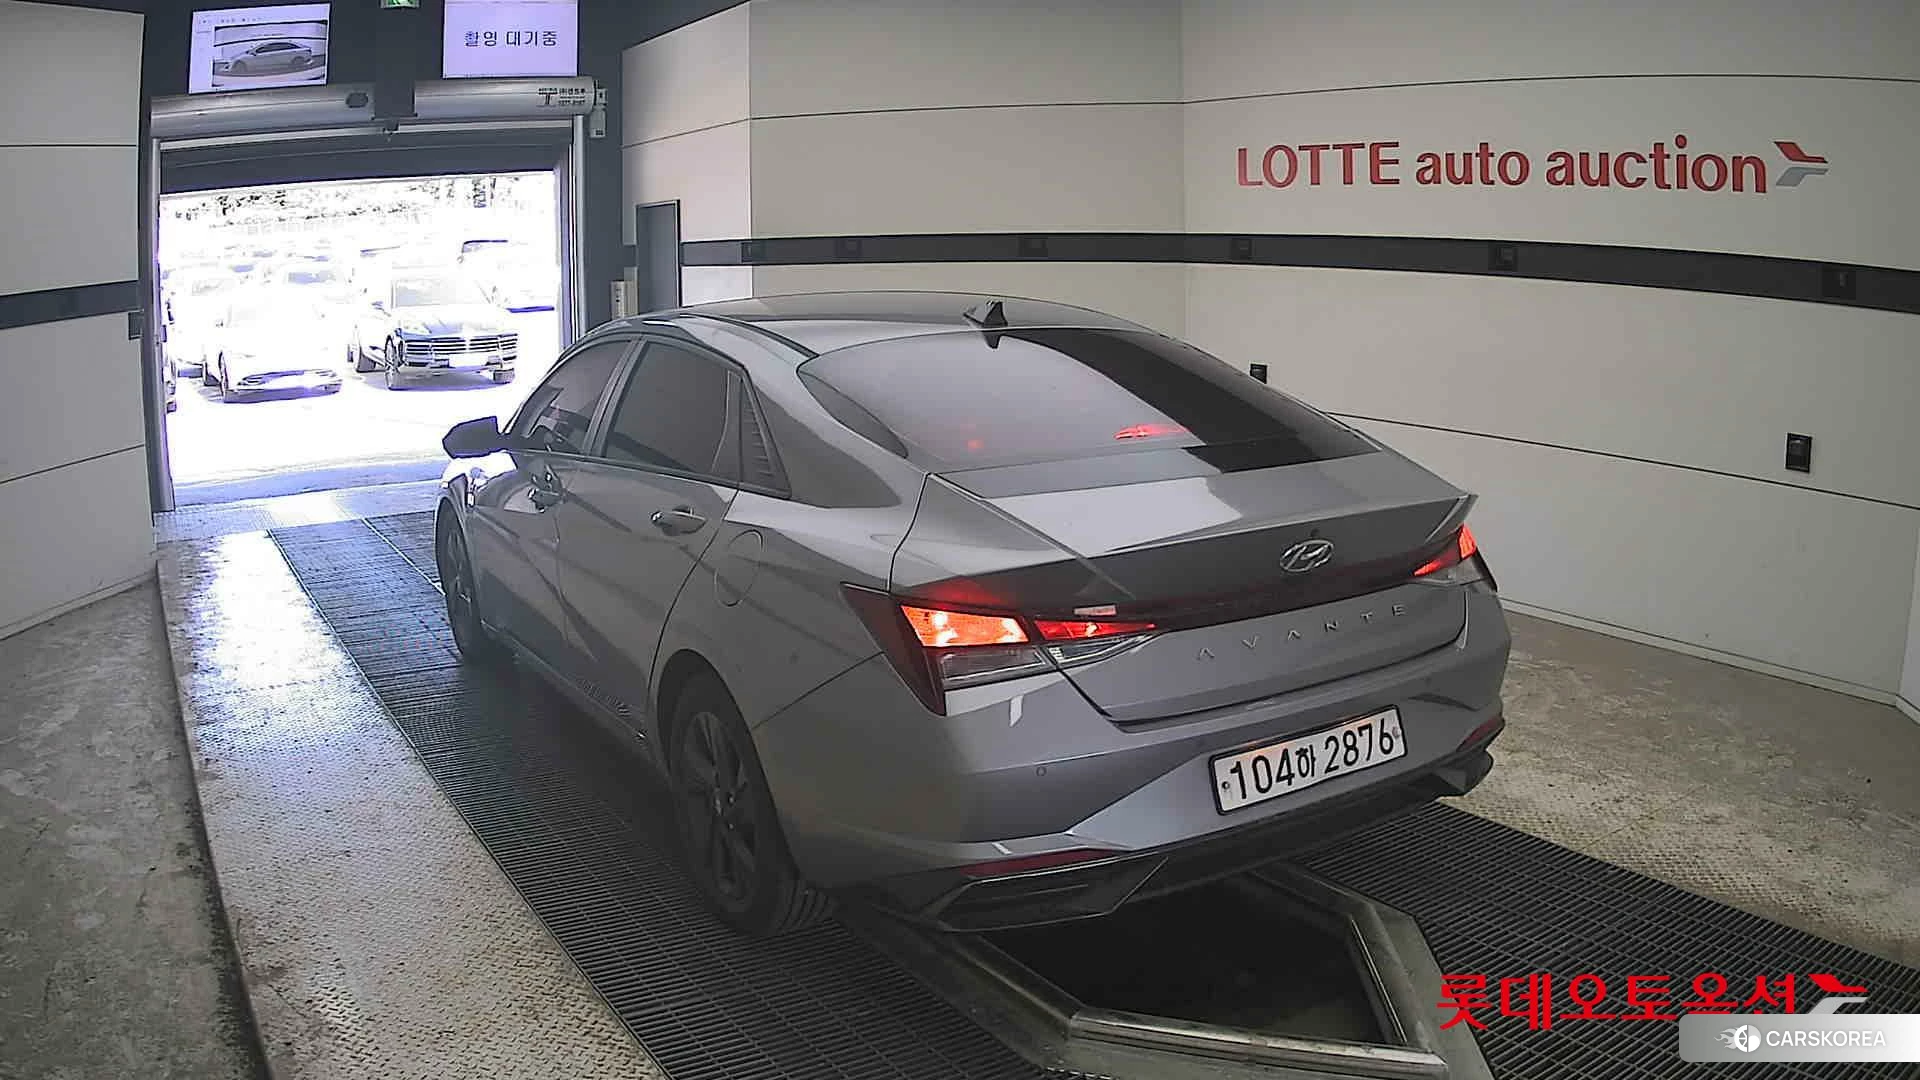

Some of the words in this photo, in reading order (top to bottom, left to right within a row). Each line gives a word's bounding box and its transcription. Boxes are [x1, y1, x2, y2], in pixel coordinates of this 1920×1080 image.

[506, 31, 557, 47] 대기중
[1237, 141, 1400, 188] LOTTE
[1416, 142, 1530, 185] auto
[1545, 134, 1767, 194] auction
[1197, 605, 1406, 660] AVANTE
[1230, 744, 1316, 799] 104하
[1324, 718, 1394, 774] 2876
